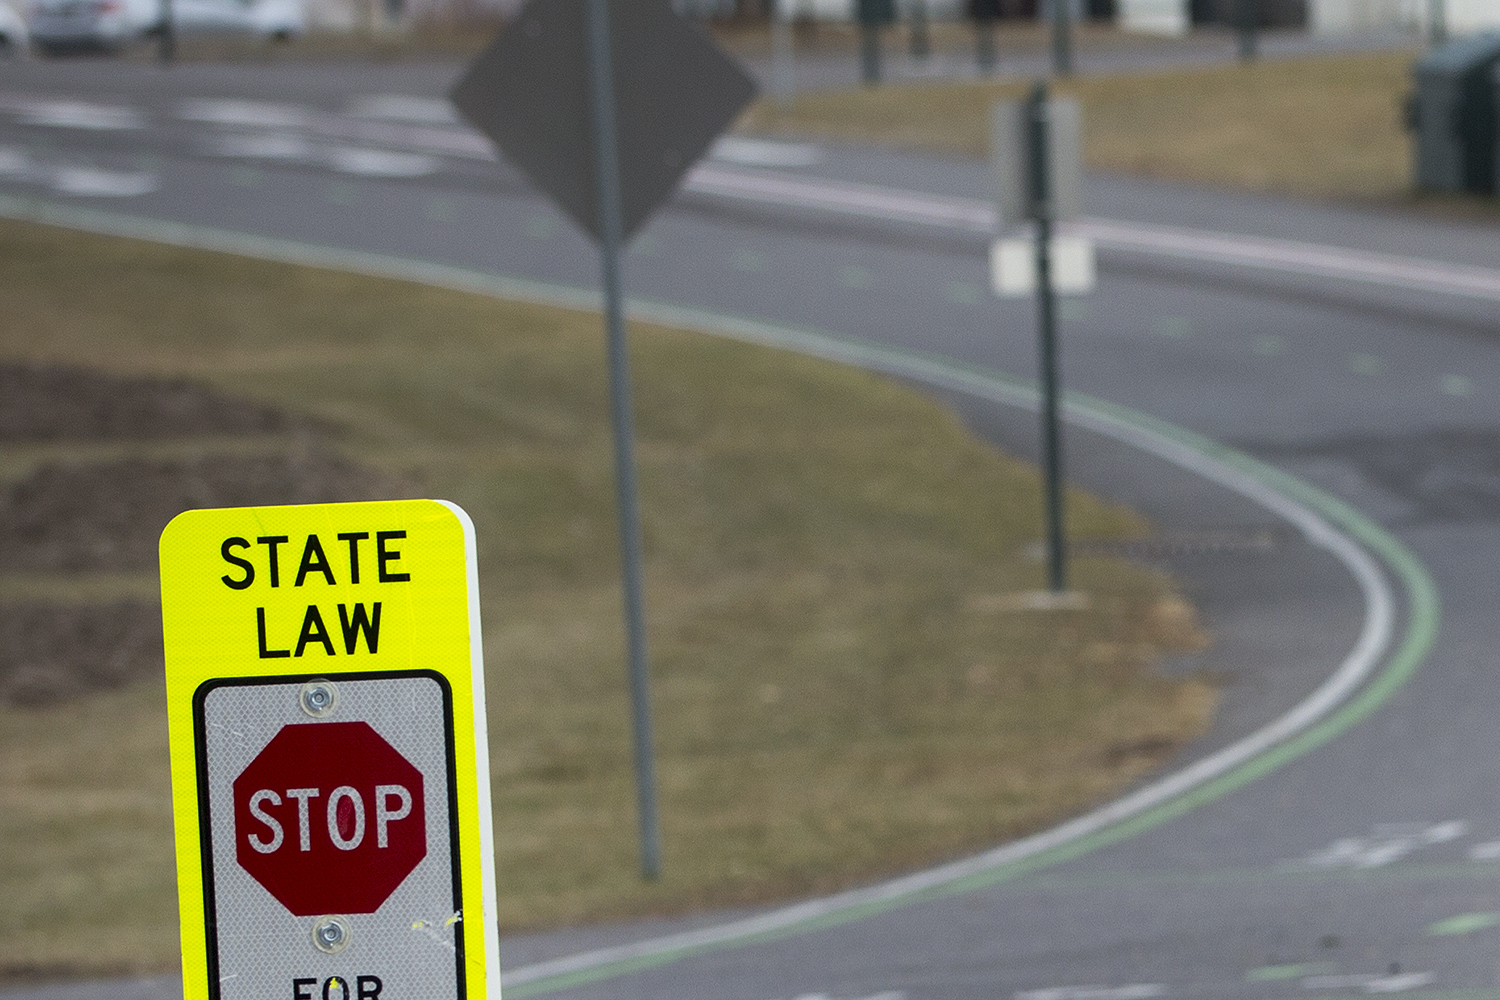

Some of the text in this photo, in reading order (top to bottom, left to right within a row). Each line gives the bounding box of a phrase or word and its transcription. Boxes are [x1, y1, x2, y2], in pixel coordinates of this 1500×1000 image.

[220, 530, 411, 590] STATE
[256, 602, 382, 659] LAW
[246, 784, 413, 854] STOP
